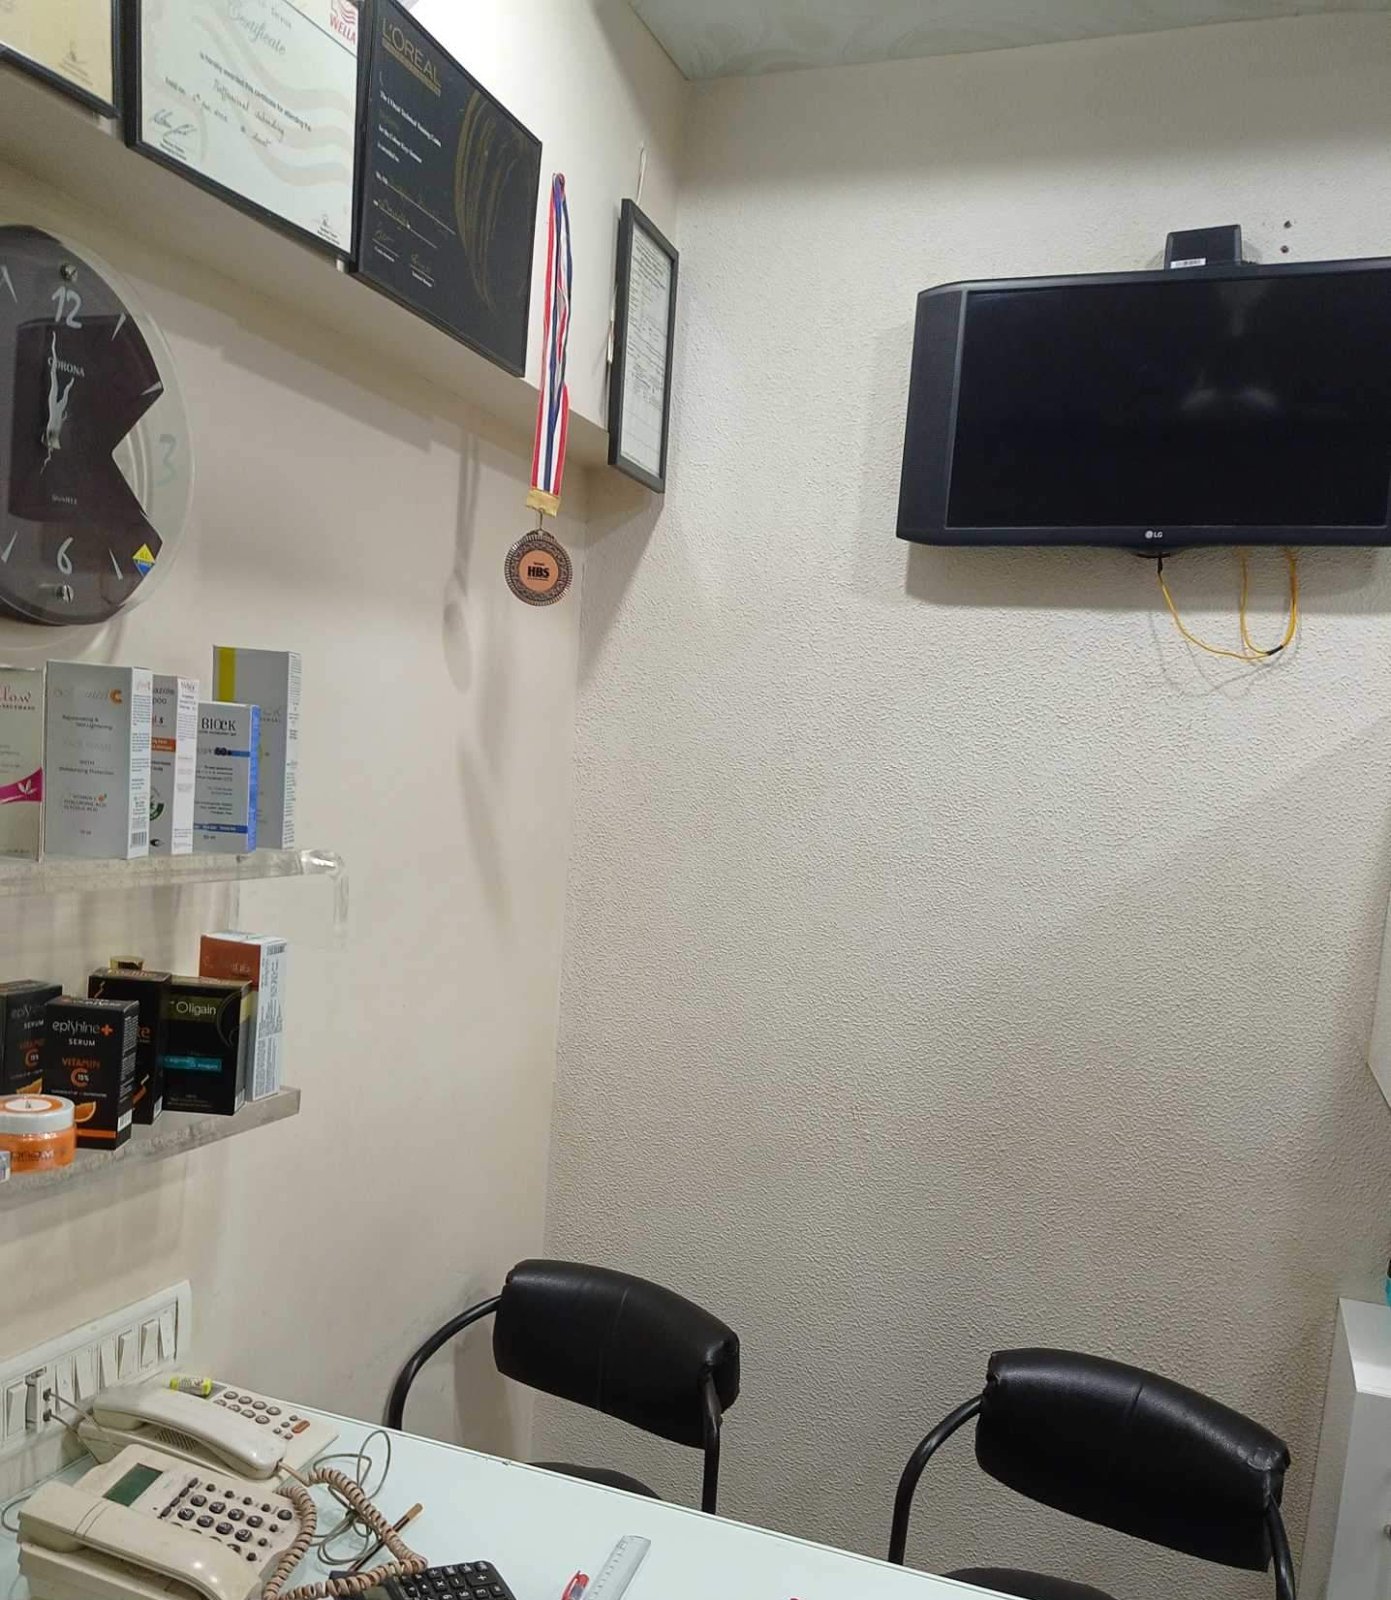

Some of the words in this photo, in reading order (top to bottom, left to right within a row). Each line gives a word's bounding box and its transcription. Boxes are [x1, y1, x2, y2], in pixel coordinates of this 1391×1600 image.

[330, 12, 356, 45] WELLA
[52, 286, 82, 328] 12
[57, 537, 73, 574] 6
[527, 565, 550, 578] HBS
[176, 1001, 216, 1016] Oligain
[68, 1037, 95, 1047] SERUM
[62, 1057, 101, 1069] VITAMIN
